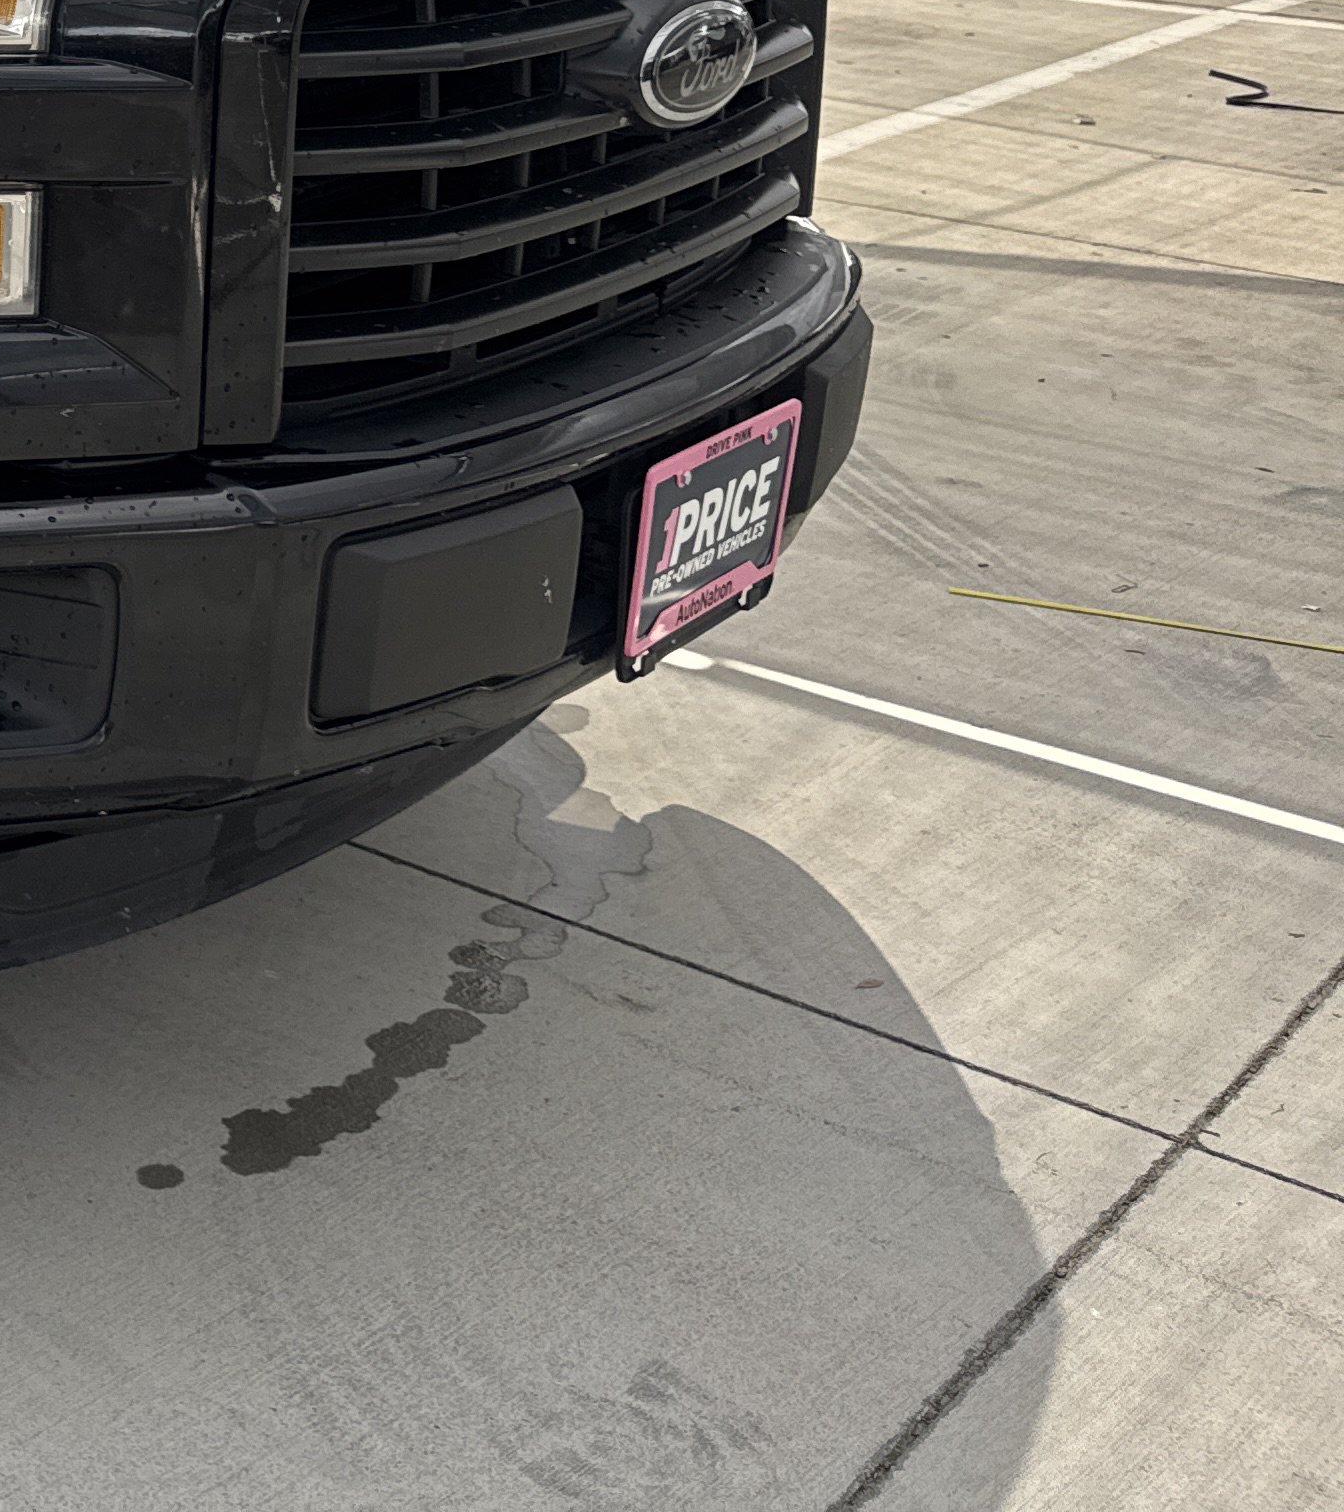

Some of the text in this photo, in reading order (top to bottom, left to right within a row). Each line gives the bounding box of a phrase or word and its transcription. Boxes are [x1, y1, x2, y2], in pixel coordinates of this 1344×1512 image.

[706, 426, 753, 459] DRIVE PINK
[650, 519, 767, 597] PRE-OWNED VEHICLES
[675, 580, 733, 626] AutoNation
